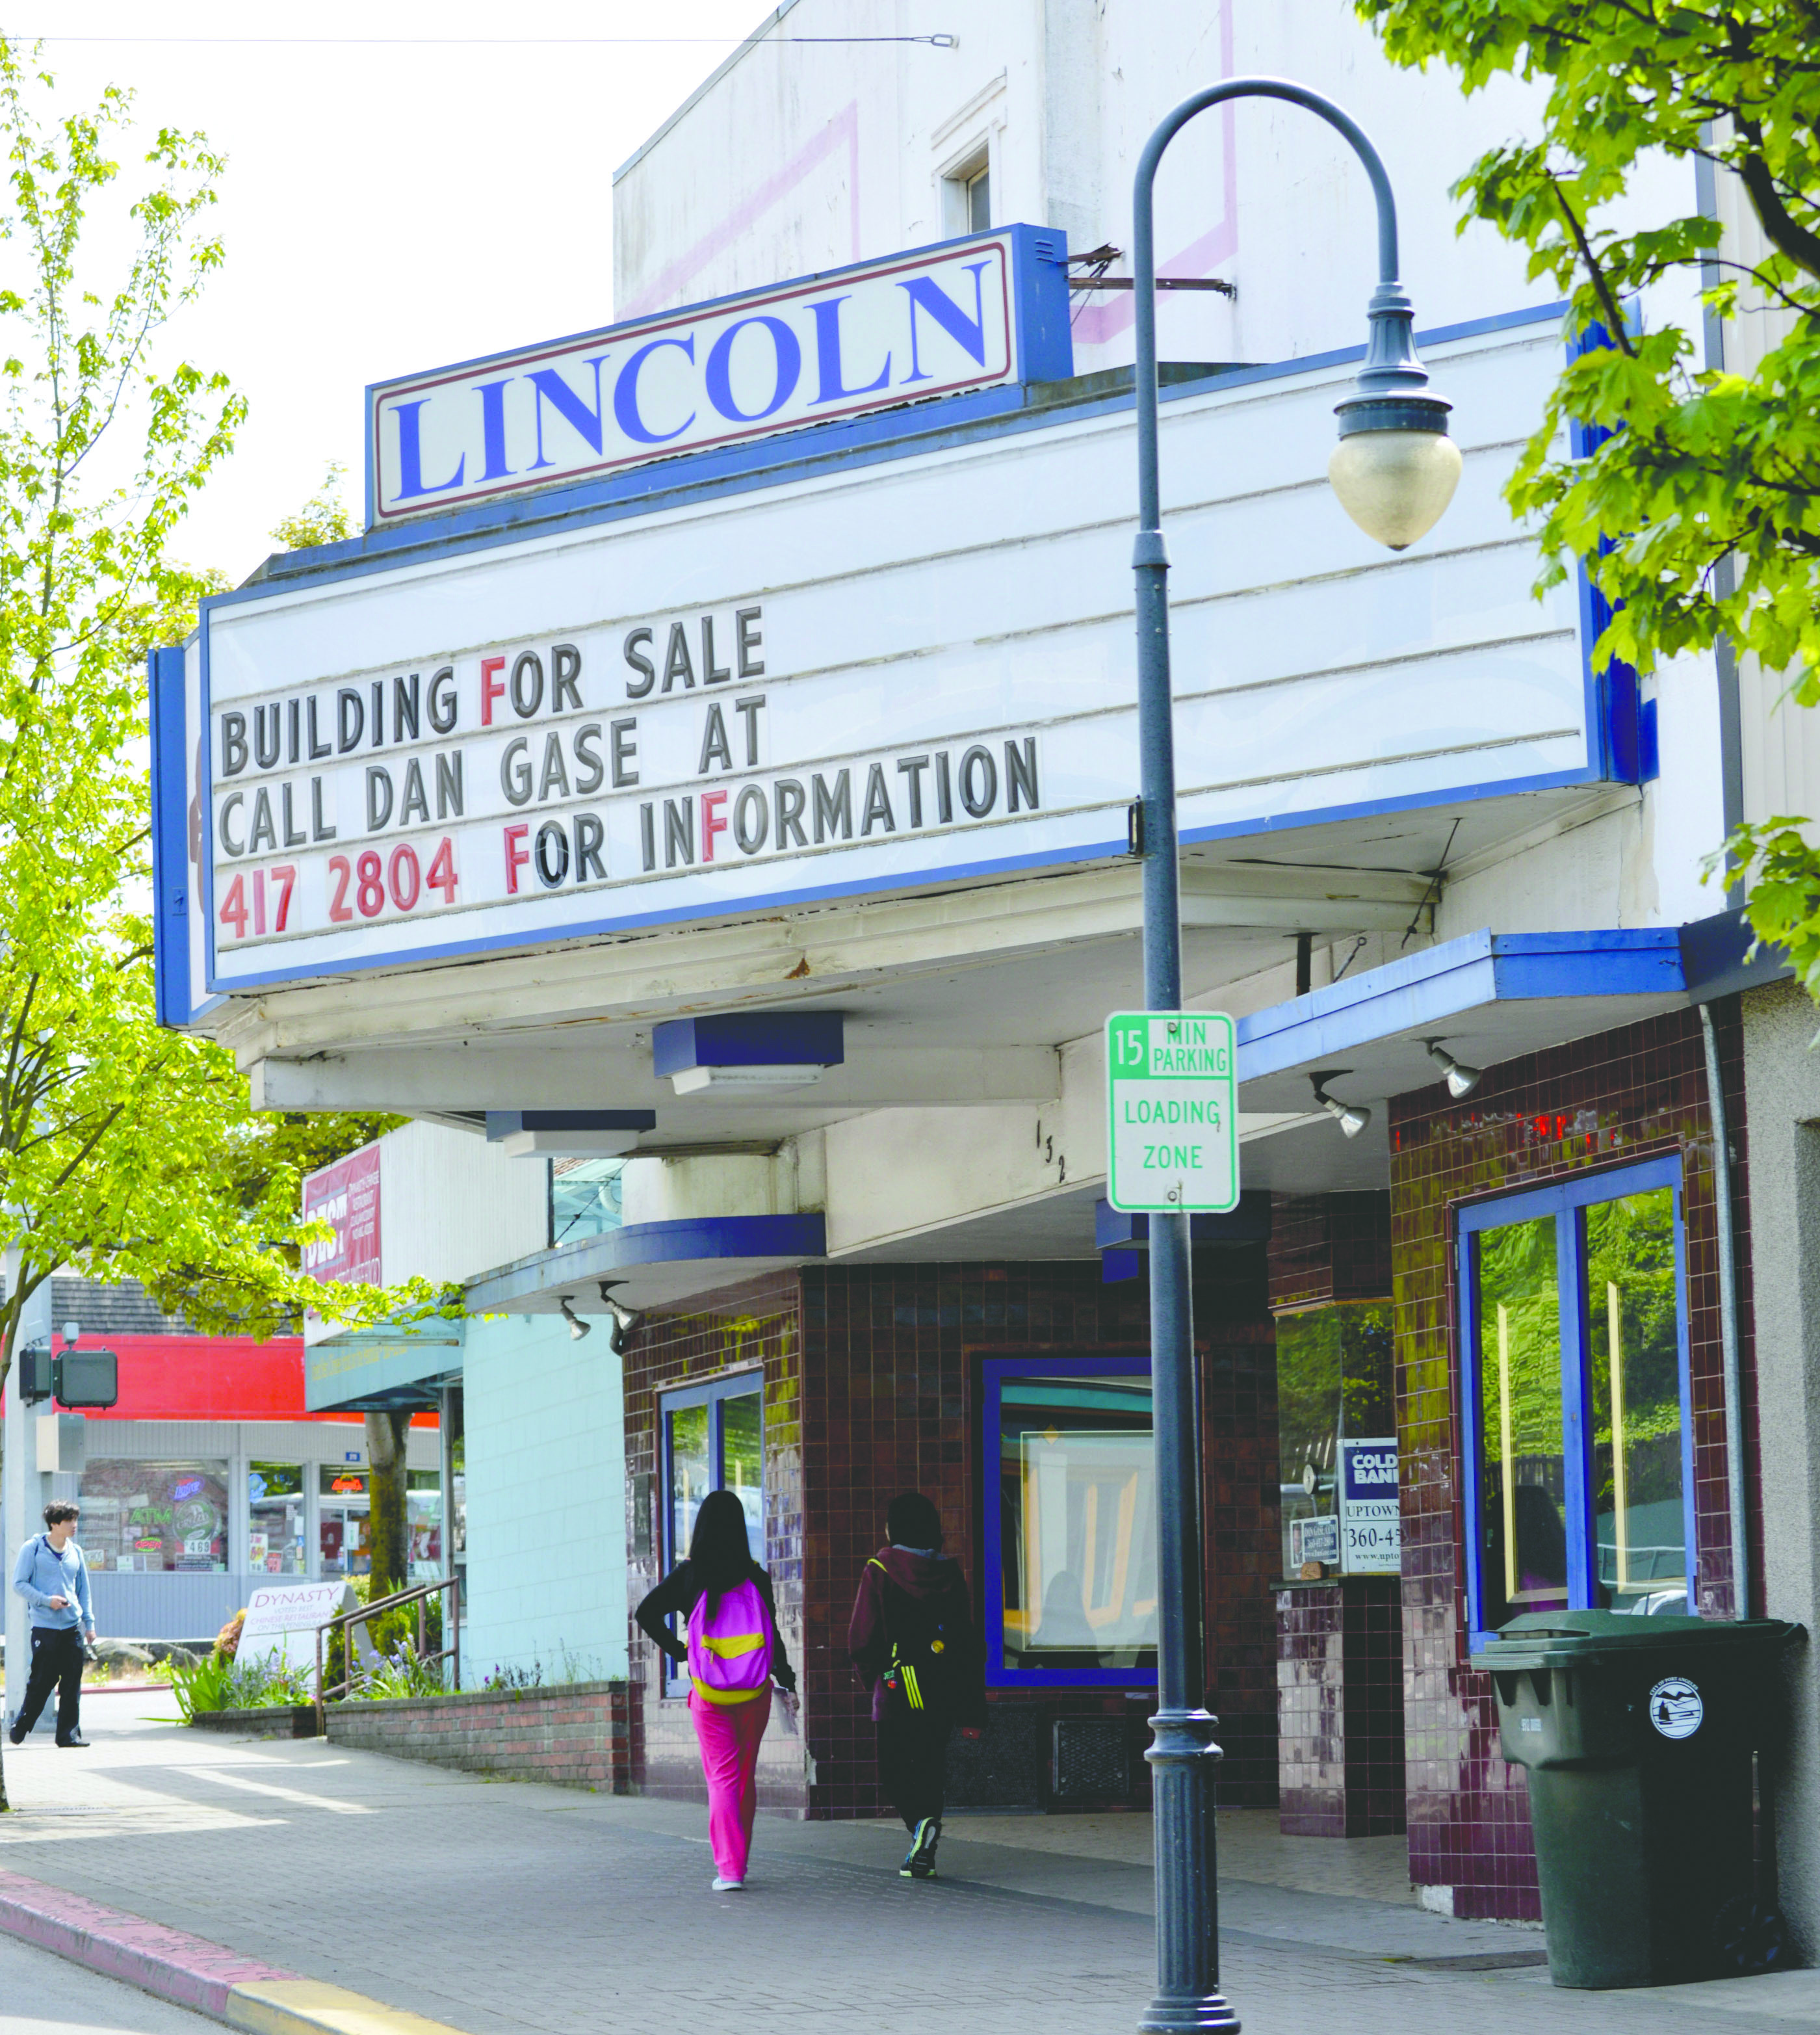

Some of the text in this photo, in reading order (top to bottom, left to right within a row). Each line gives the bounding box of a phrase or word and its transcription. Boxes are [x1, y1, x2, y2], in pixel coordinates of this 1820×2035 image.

[388, 260, 992, 502] LINCOLN
[221, 605, 765, 778] BUILDING FOR SALE
[218, 694, 766, 858] CALL DAN GASE AT
[219, 736, 1040, 939] 417 2804 FOR INFORMATION
[1167, 1021, 1206, 1045] MIN
[1115, 1029, 1144, 1066] 15
[1154, 1048, 1227, 1072] PARKING
[1124, 1099, 1219, 1124] LOADING
[1143, 1145, 1203, 1169] ZONE
[1352, 1453, 1398, 1469] COLD
[130, 1508, 173, 1525] ATM
[135, 1540, 162, 1549] OPEN
[255, 1586, 339, 1608] DYNASTY
[250, 1614, 281, 1625] CHINESE
